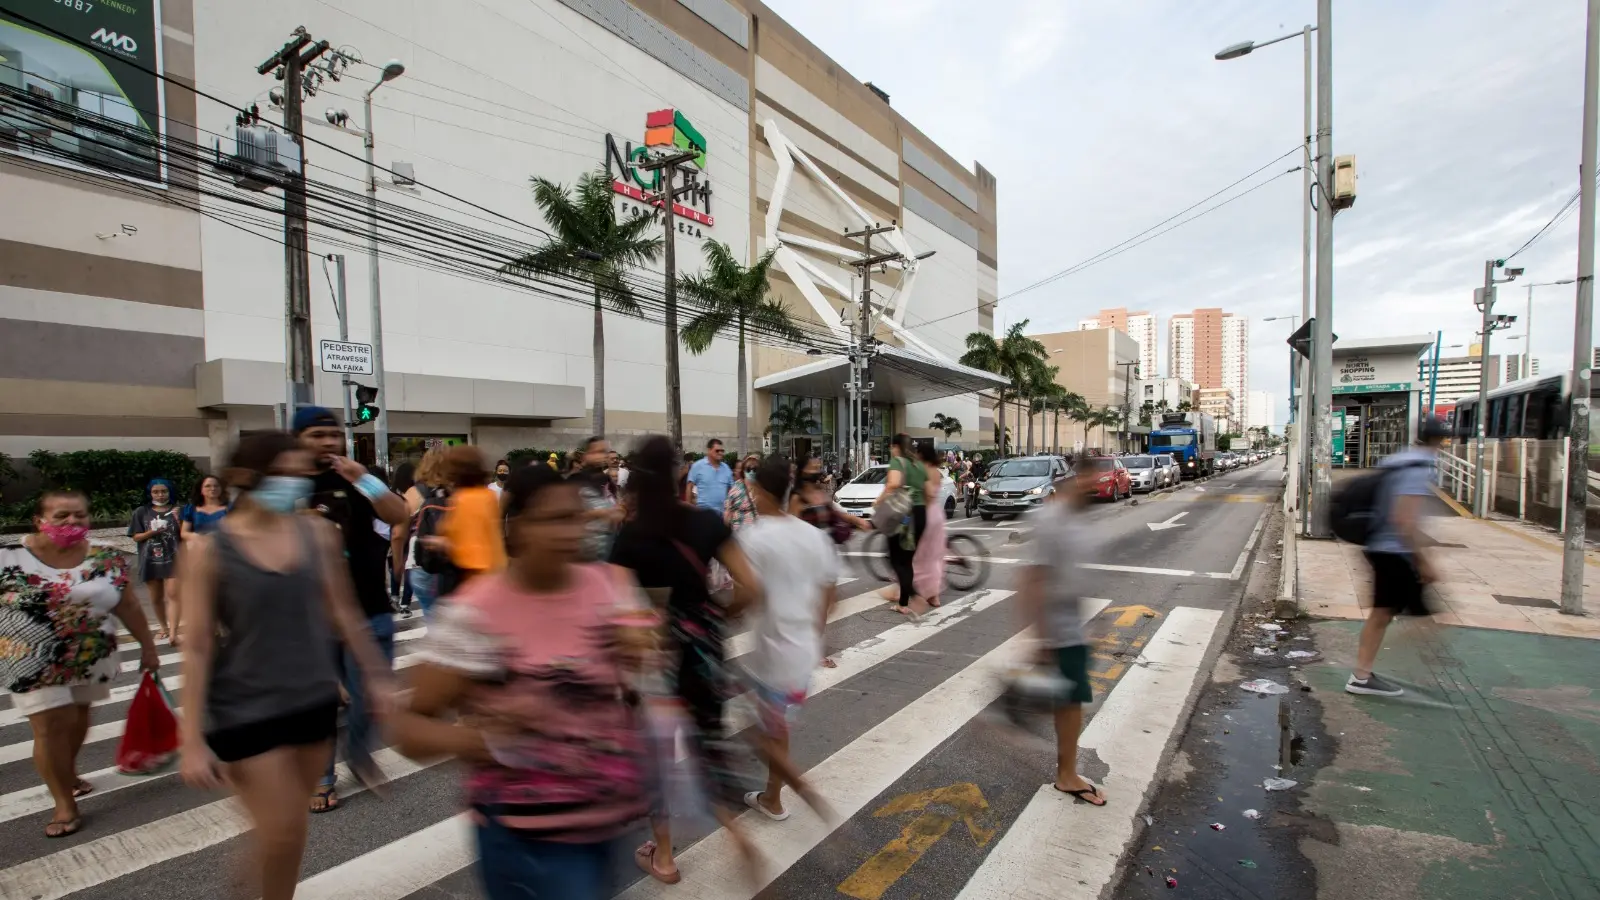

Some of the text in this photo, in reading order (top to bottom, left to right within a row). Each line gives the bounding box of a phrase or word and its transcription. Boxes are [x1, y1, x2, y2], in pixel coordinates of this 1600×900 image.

[54, 0, 93, 13] 887
[324, 343, 370, 354] PEDESTRE
[326, 354, 368, 363] ATRAVESSE
[343, 363, 364, 372] FAIXA
